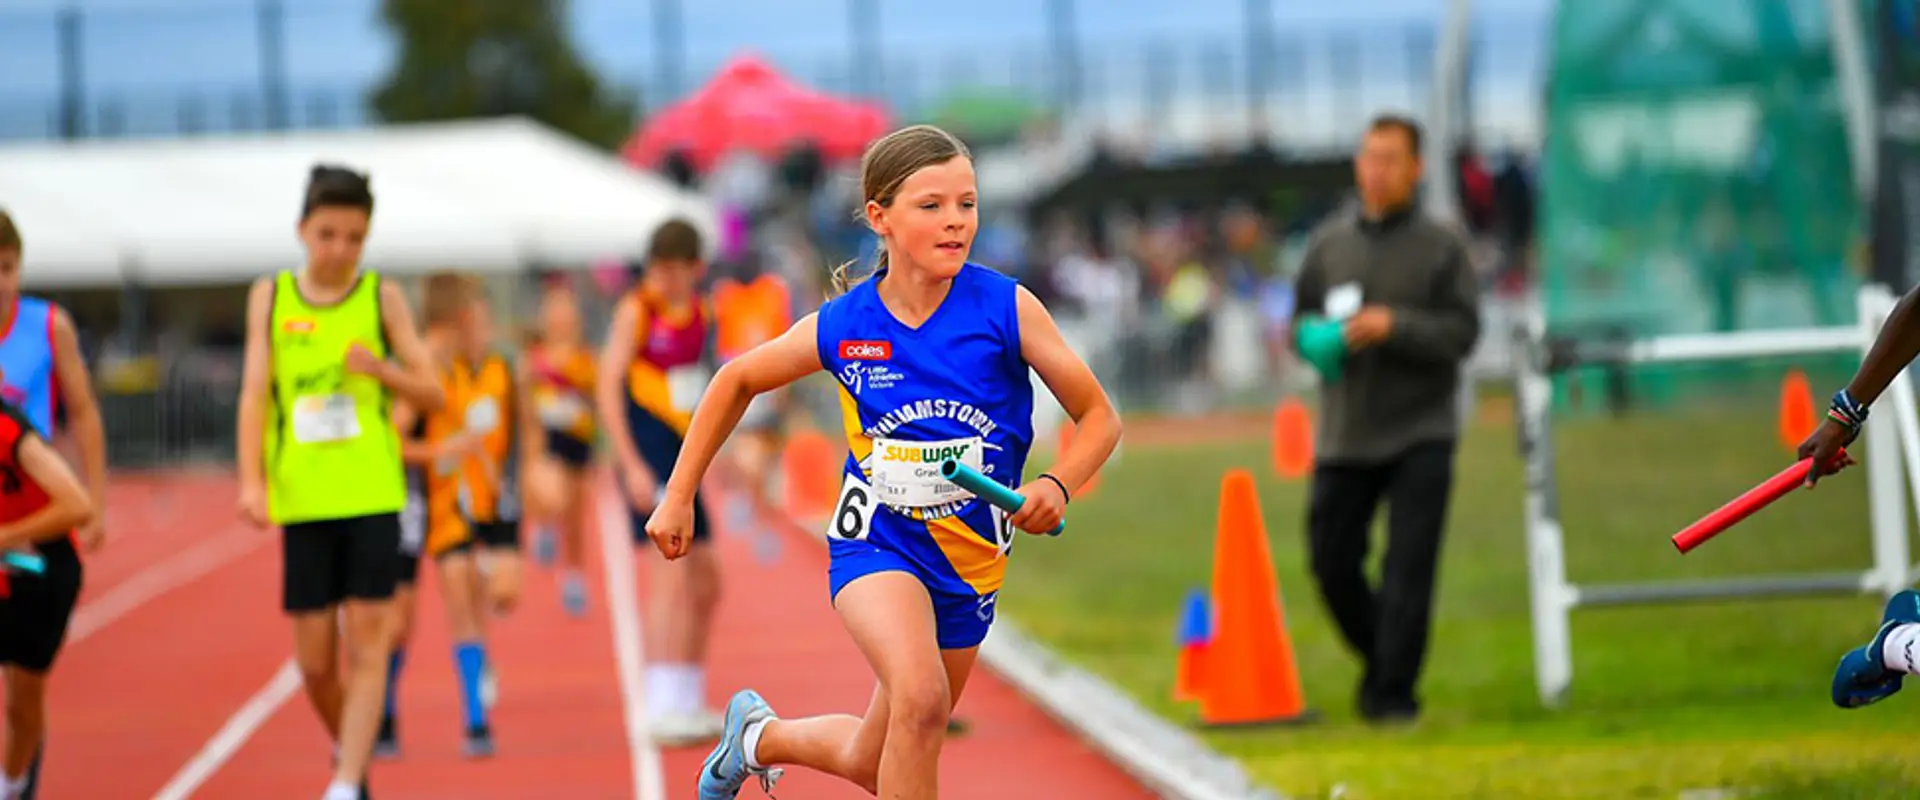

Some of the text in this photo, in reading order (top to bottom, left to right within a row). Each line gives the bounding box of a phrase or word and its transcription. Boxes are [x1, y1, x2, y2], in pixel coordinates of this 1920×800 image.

[846, 343, 884, 357] coles
[882, 444, 970, 463] SUBWAY
[837, 487, 868, 539] 6
